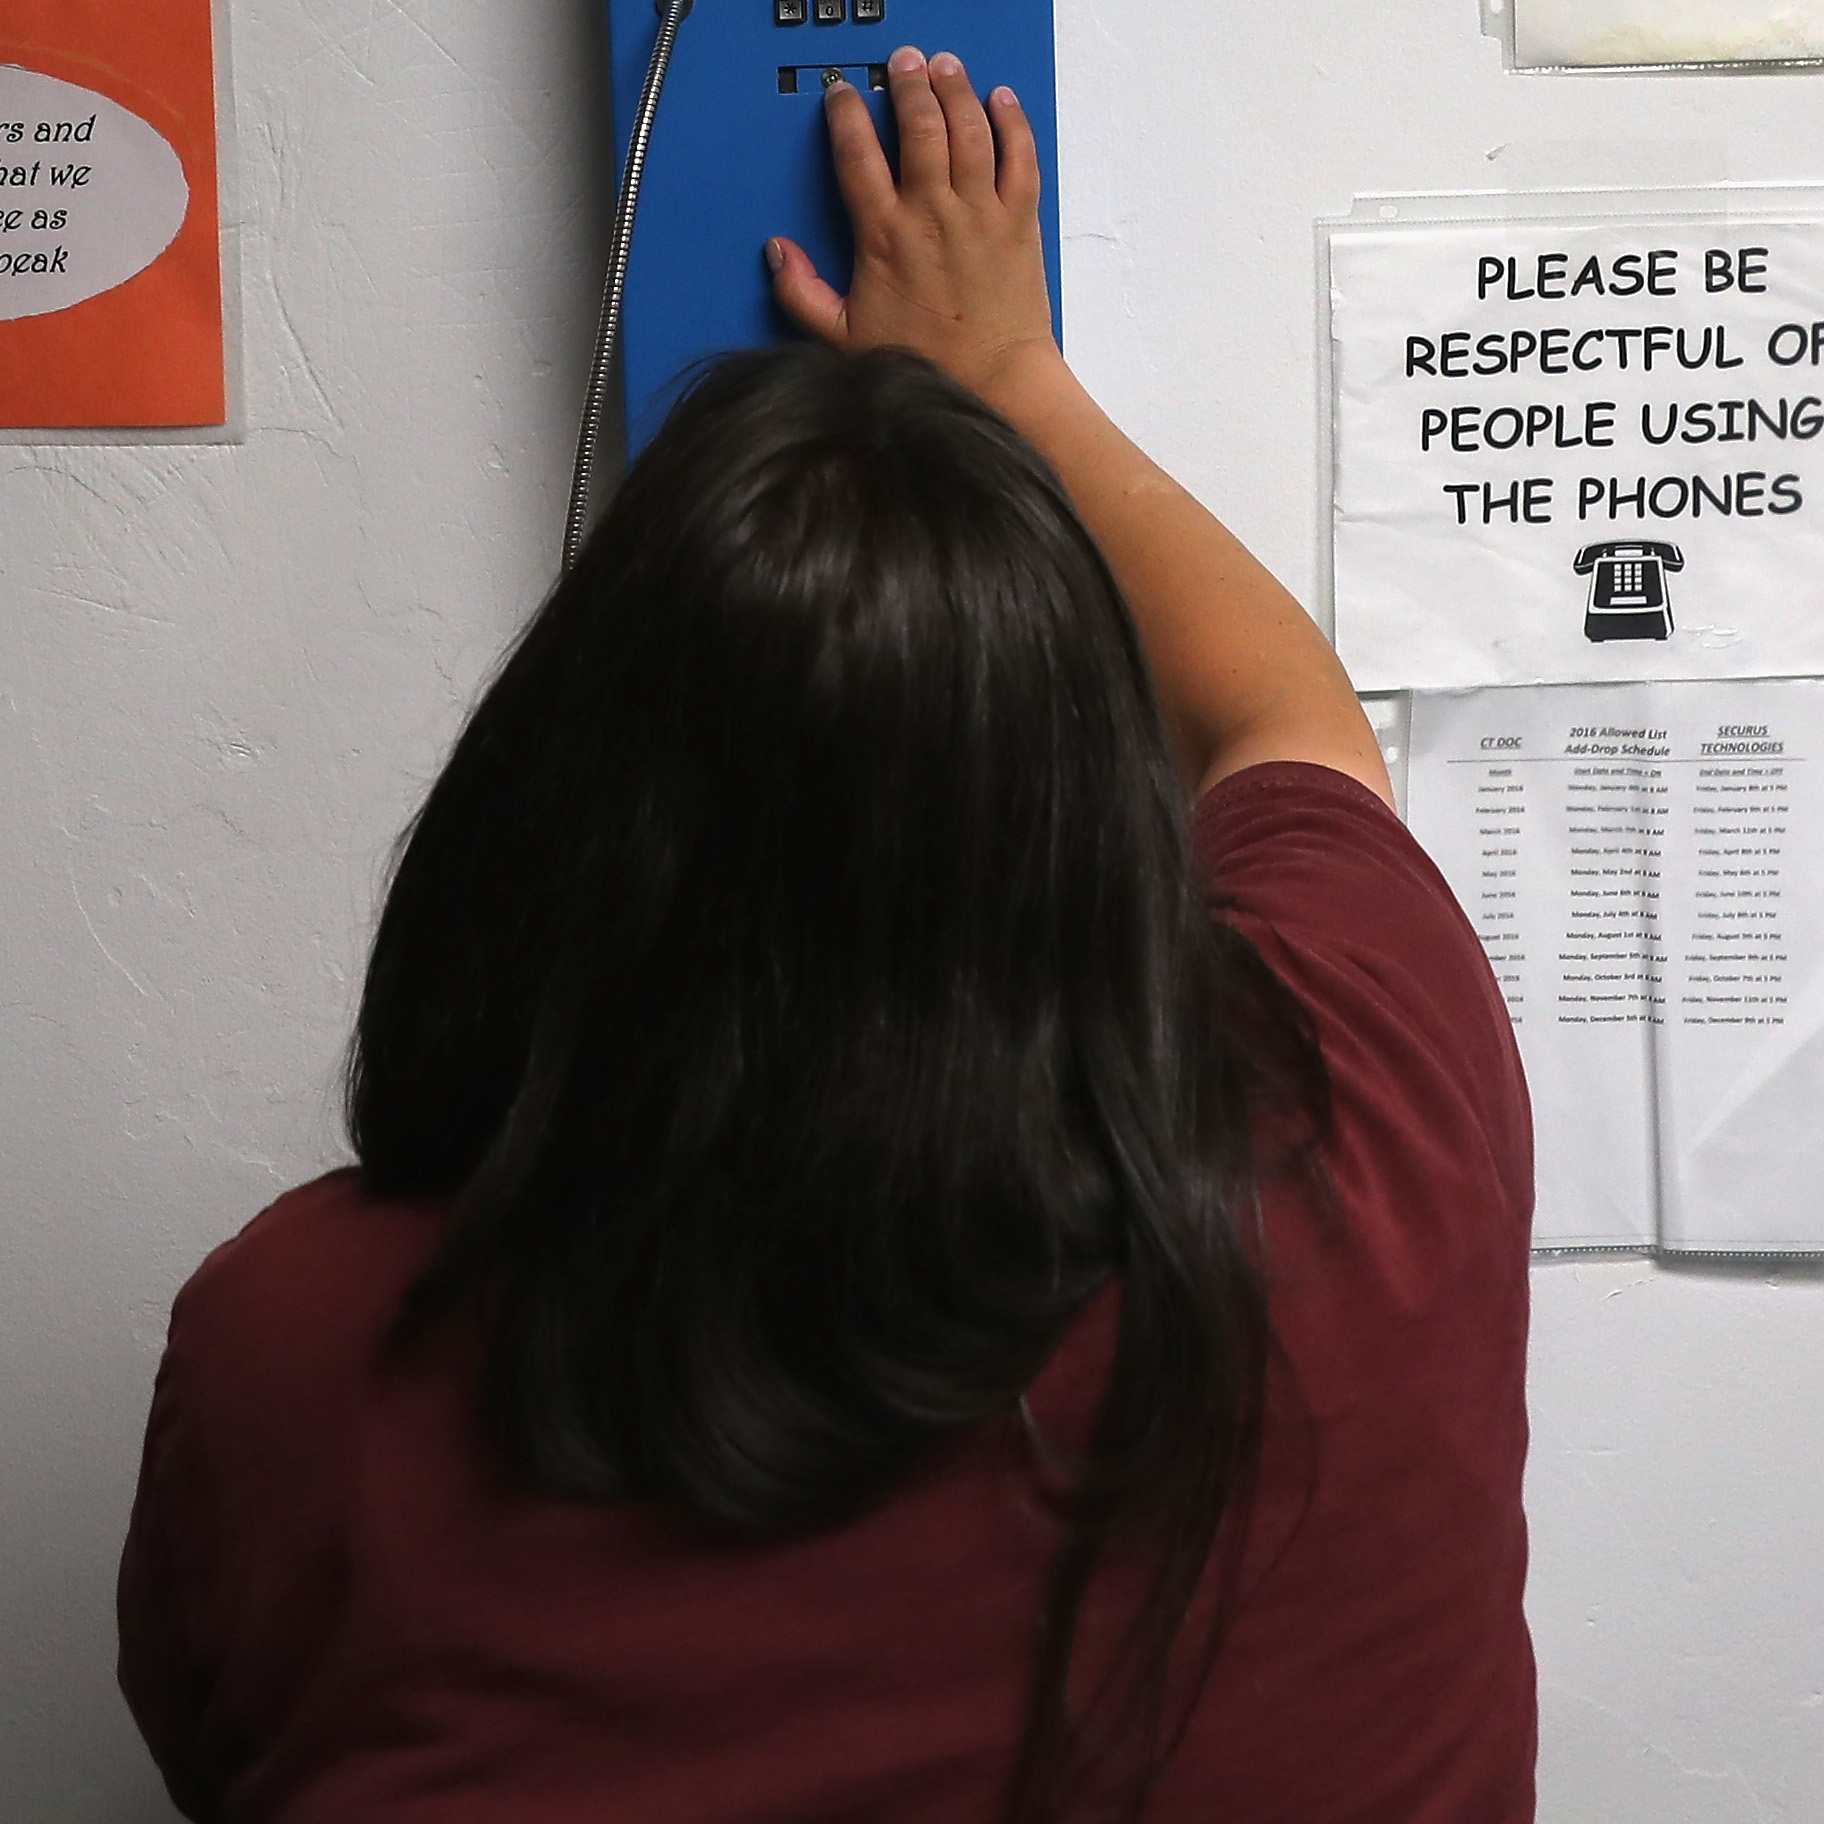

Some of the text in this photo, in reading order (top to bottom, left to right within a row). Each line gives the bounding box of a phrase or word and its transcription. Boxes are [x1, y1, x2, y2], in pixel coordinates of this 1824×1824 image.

[34, 114, 96, 142] and
[51, 164, 91, 189] we
[31, 210, 67, 230] as
[1478, 247, 1769, 300] PLEASE BE
[1406, 325, 1744, 377] RESPECTFUL
[1422, 402, 1616, 452] PEOPLE
[1443, 471, 1803, 524] THE PHONES
[1569, 726, 1667, 740] 2016 Allowed List
[1717, 723, 1768, 737] SECURUS
[1480, 736, 1522, 750] CT DOC
[1563, 743, 1671, 759] Add-Drop Schedule
[1700, 741, 1785, 755] TECHNOLOGIES
